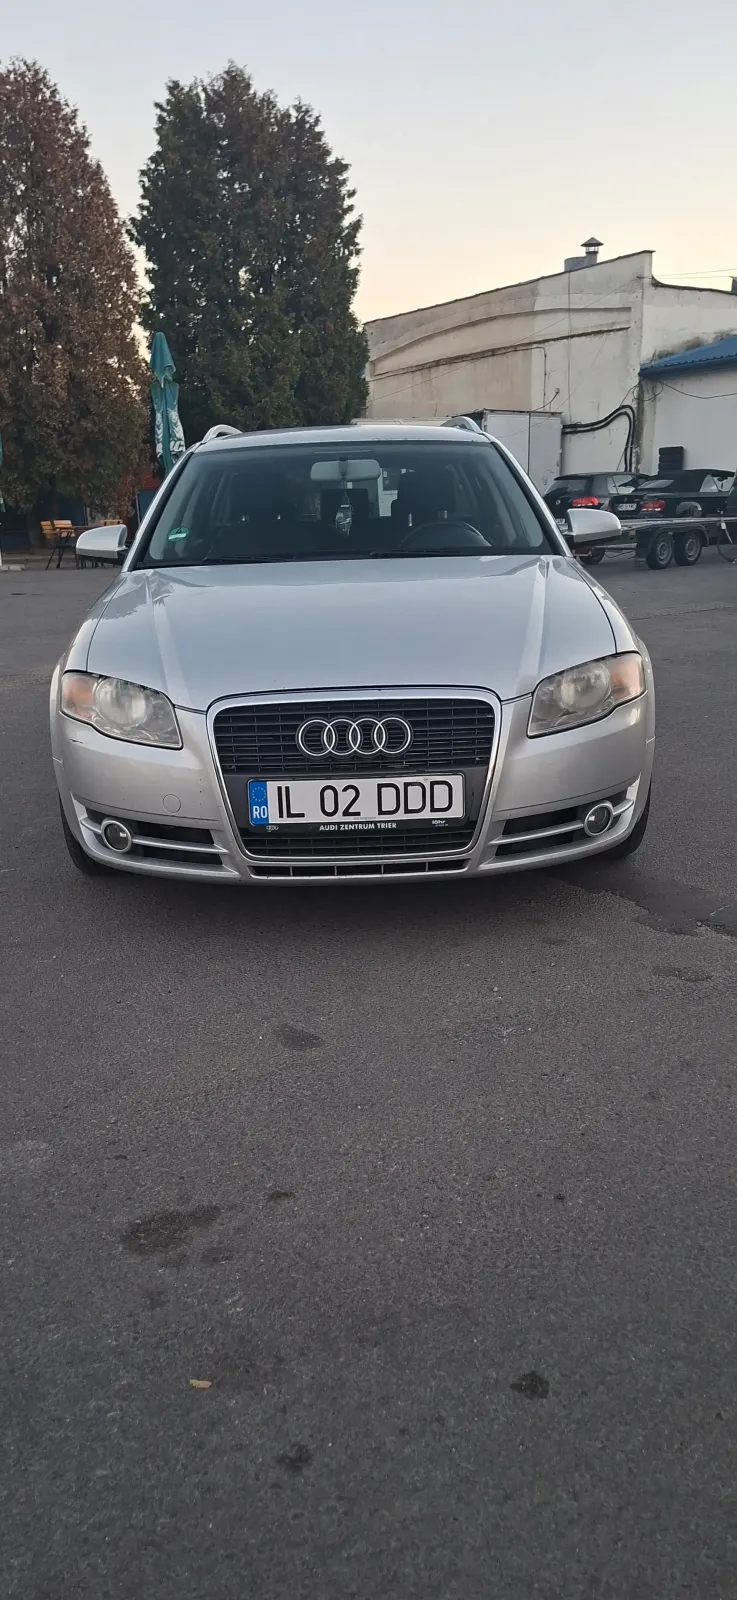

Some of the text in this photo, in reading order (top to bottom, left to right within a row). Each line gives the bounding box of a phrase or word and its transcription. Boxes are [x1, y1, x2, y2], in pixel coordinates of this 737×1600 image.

[253, 805, 268, 819] RO
[276, 780, 453, 819] IL 02 DDD
